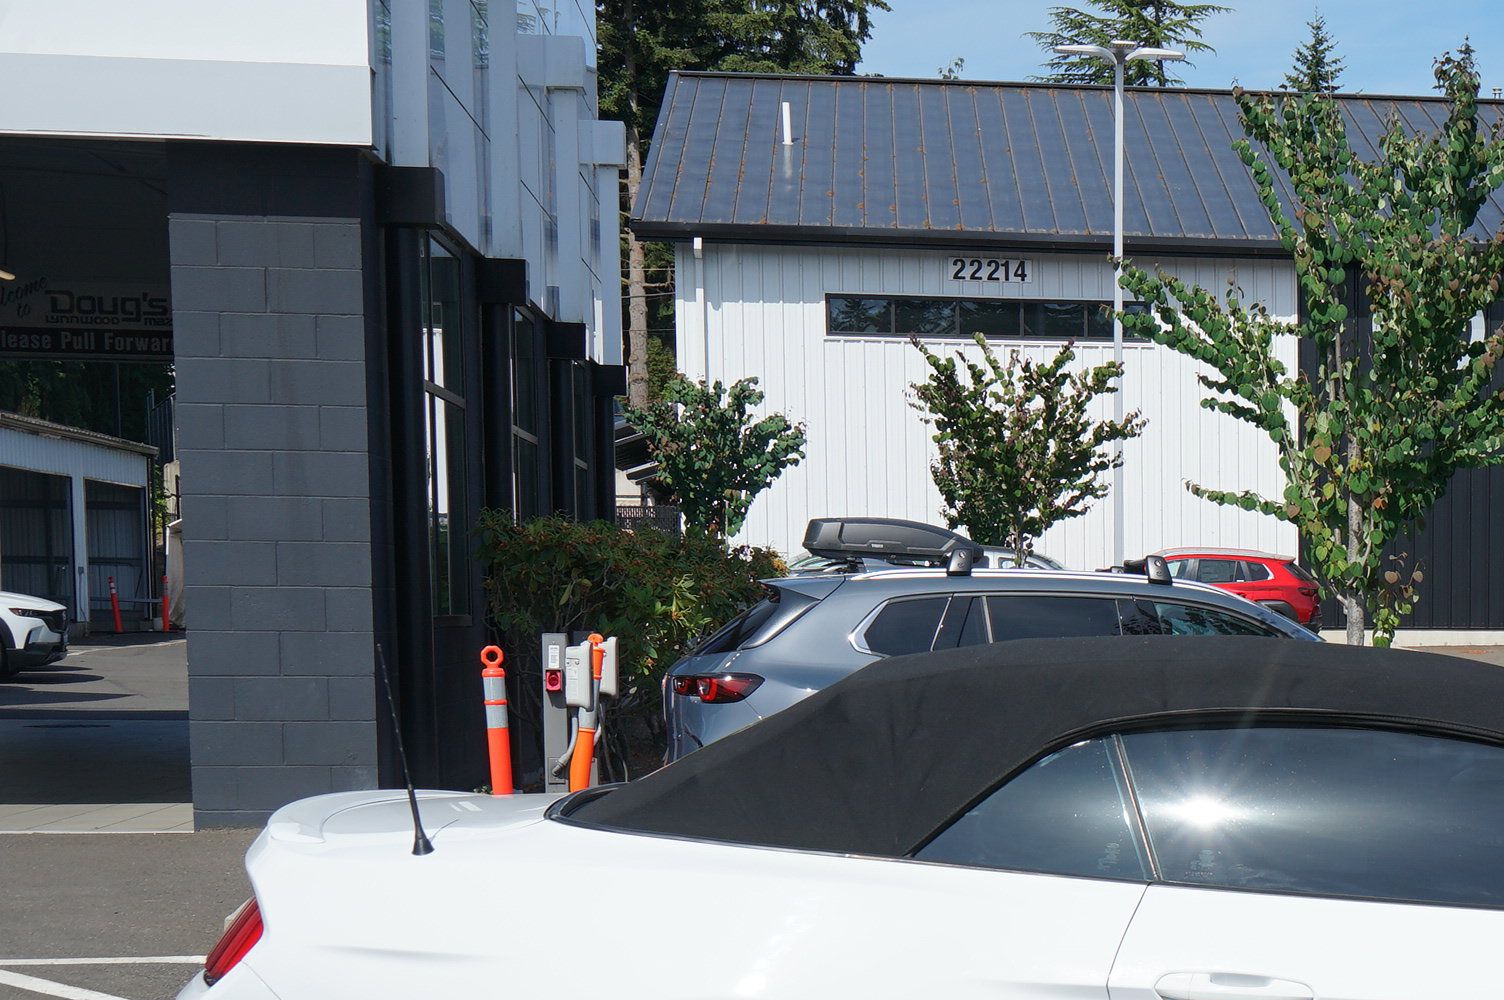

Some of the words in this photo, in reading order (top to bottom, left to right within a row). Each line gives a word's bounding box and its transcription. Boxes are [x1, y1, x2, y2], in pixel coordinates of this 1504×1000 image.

[952, 258, 1027, 282] 22214
[0, 276, 49, 306] lcome
[45, 289, 169, 323] Doug's
[1, 330, 51, 349] lease
[60, 331, 96, 350] Pull
[104, 332, 170, 352] Forwar
